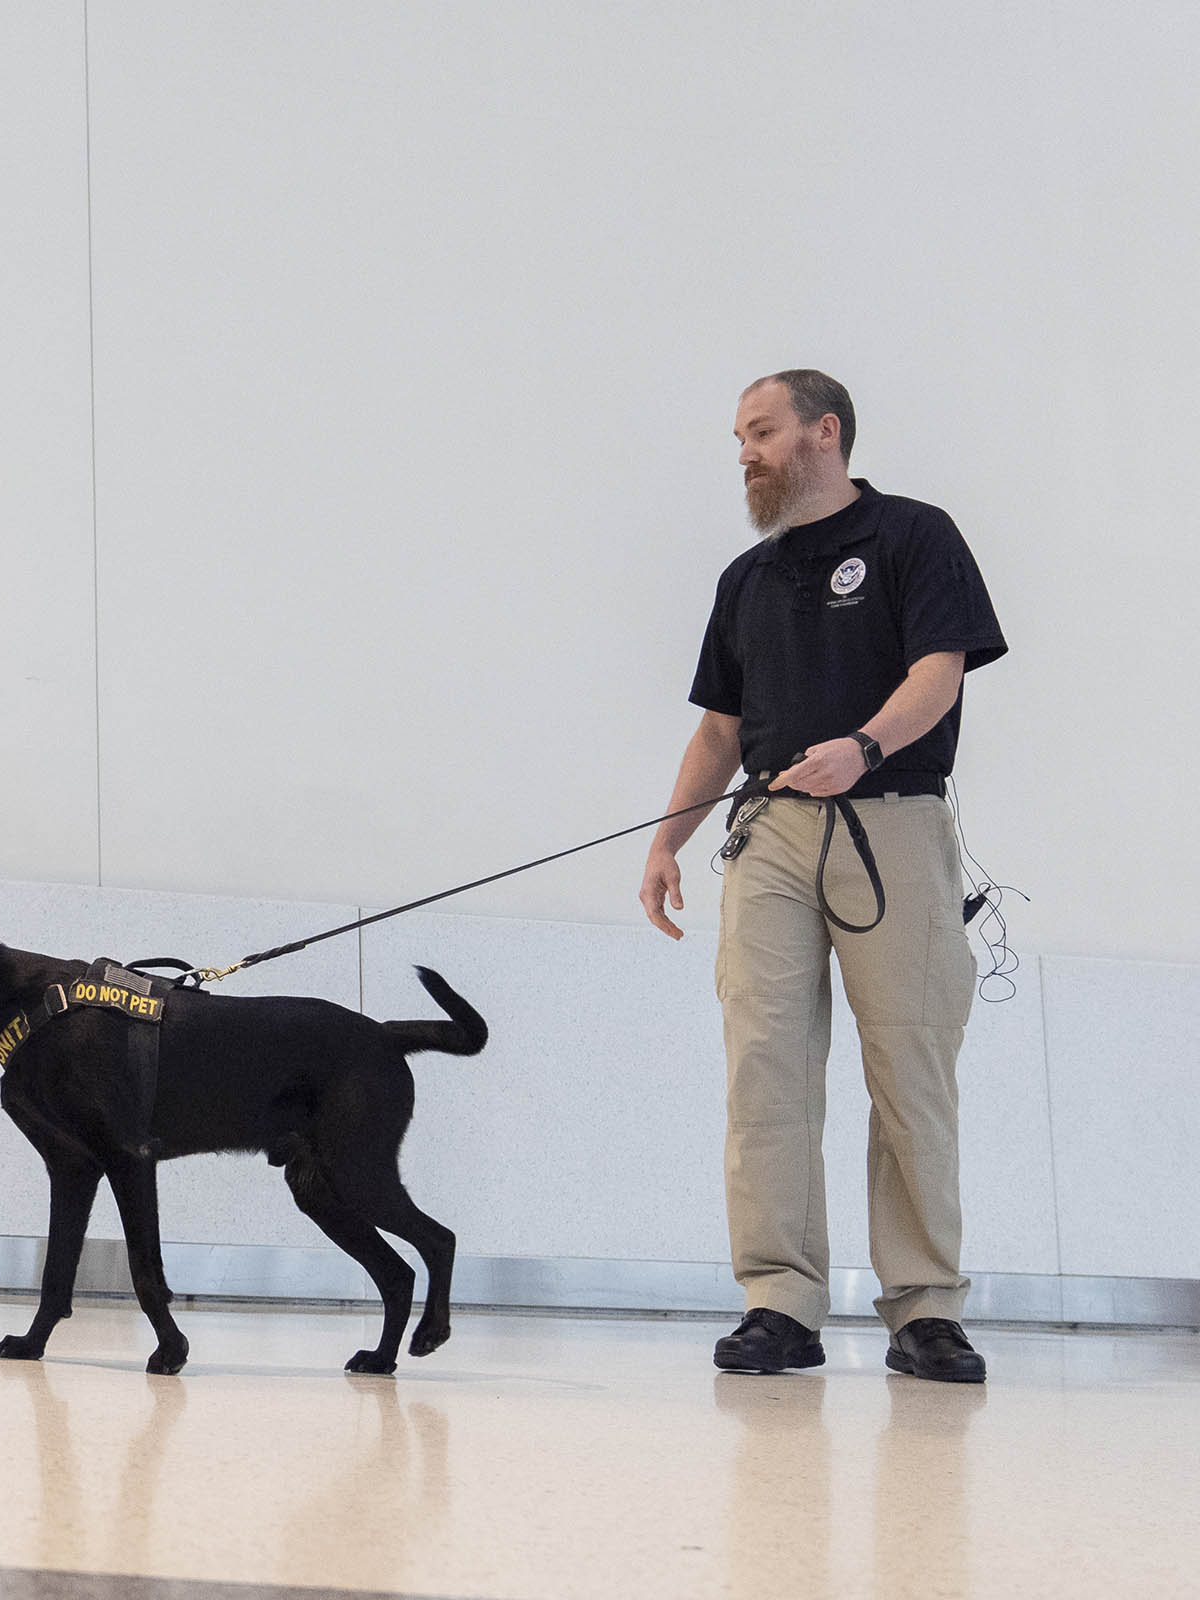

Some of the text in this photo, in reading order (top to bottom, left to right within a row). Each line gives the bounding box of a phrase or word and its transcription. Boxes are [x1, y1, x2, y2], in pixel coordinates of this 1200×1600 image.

[75, 983, 158, 1015] DO NOT PET
